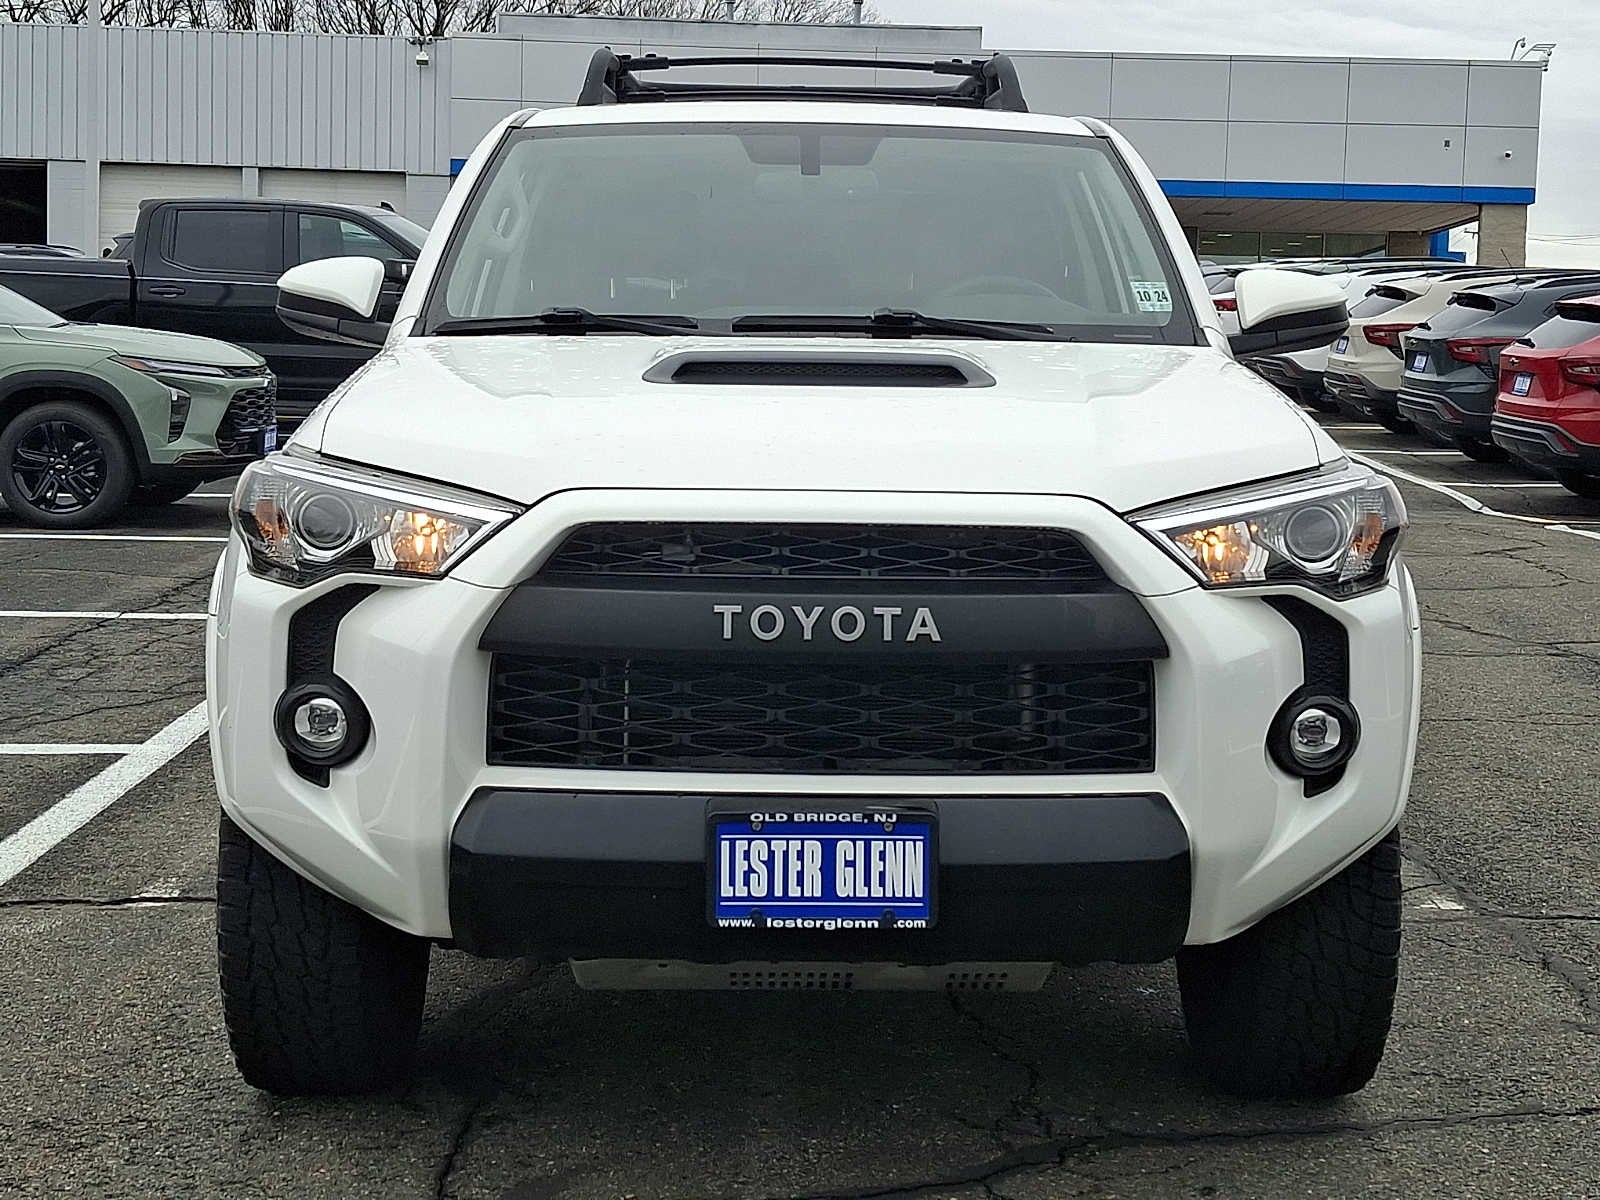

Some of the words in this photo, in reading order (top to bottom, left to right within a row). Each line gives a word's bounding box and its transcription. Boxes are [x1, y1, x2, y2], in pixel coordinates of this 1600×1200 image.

[1137, 291, 1151, 302] 10
[1154, 291, 1169, 302] 24
[713, 604, 942, 642] TOYOTA
[750, 813, 788, 822] OLD
[793, 813, 868, 823] BRIDGE,
[874, 814, 897, 822] NJ
[720, 840, 822, 898] LESTER
[836, 840, 924, 898] GLENN
[718, 919, 755, 928] www.
